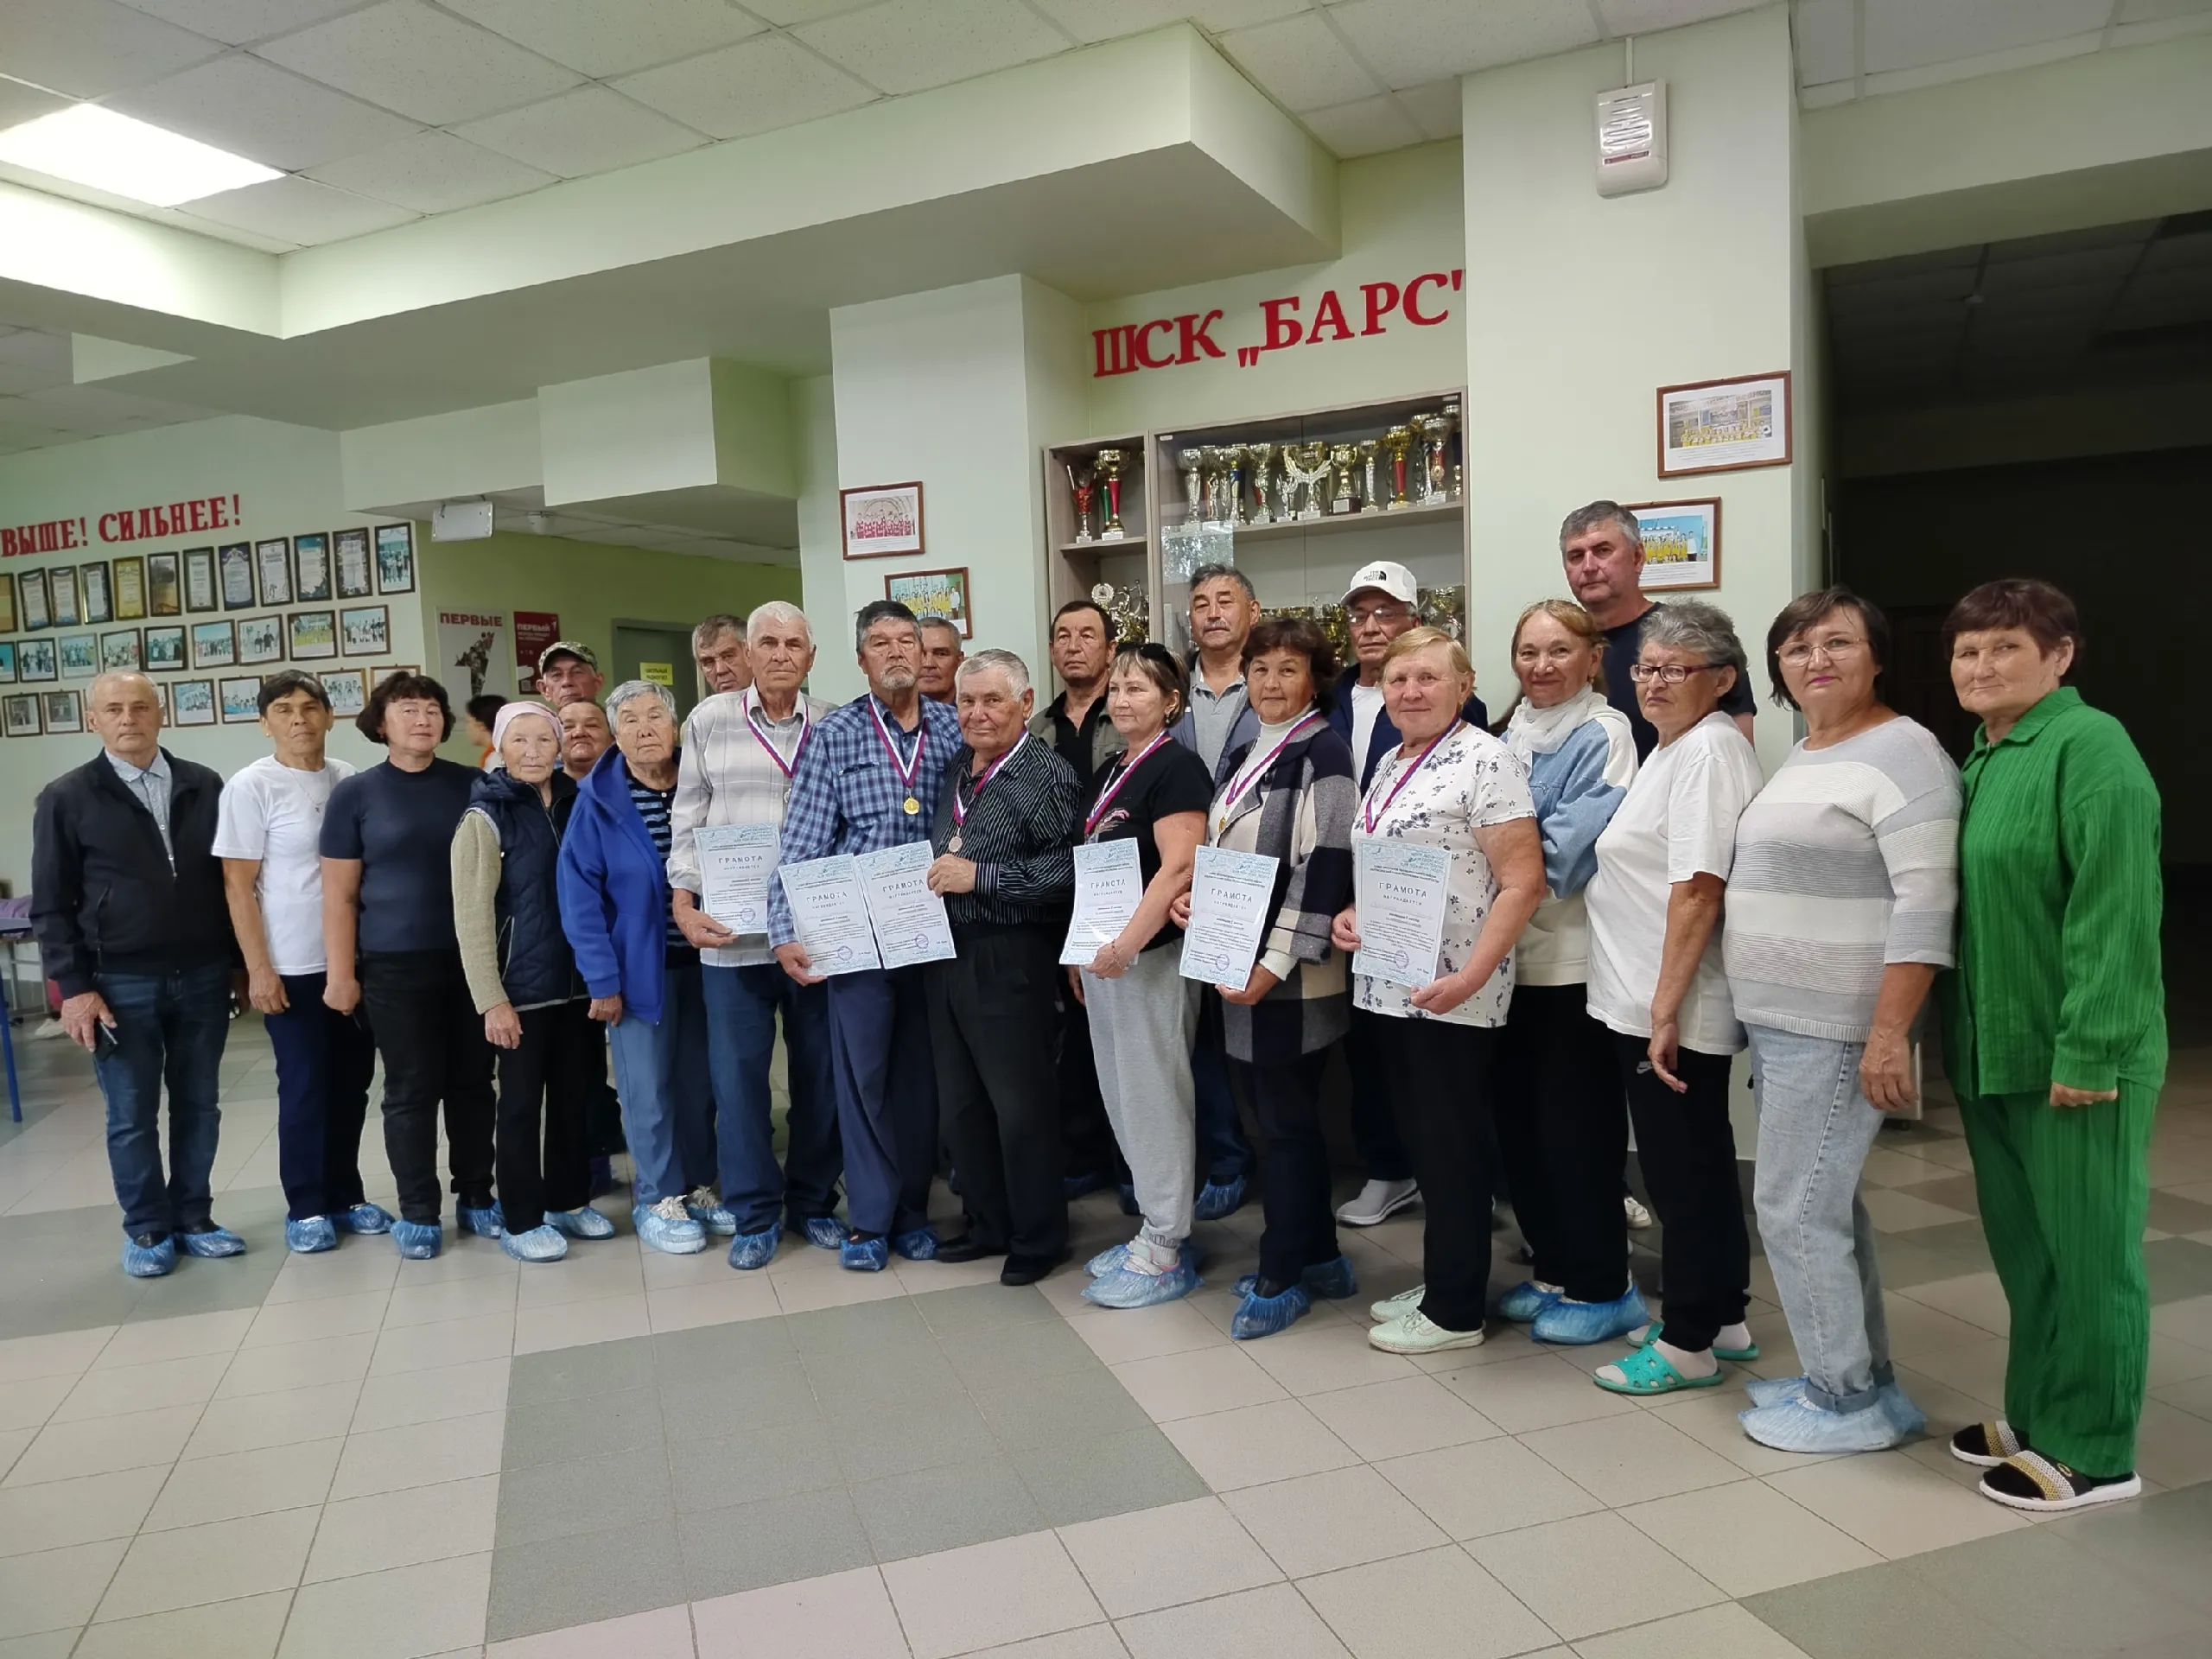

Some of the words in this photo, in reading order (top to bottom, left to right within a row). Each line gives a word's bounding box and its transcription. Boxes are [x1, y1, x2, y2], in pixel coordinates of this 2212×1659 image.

[1092, 309, 1226, 378] ШСК
[0, 517, 88, 557] ВЫШЕ!
[99, 494, 240, 543] СИЛЬНЕЕ!
[440, 613, 503, 626] ПЕРВЫЕ
[882, 879, 925, 893] ГРАМОТА
[1090, 879, 1126, 888] ГРАМОТА
[1379, 882, 1427, 898] ГРАМОТА
[806, 891, 848, 903] ГРАМОТА
[1211, 887, 1252, 903] ГРАМОТА
